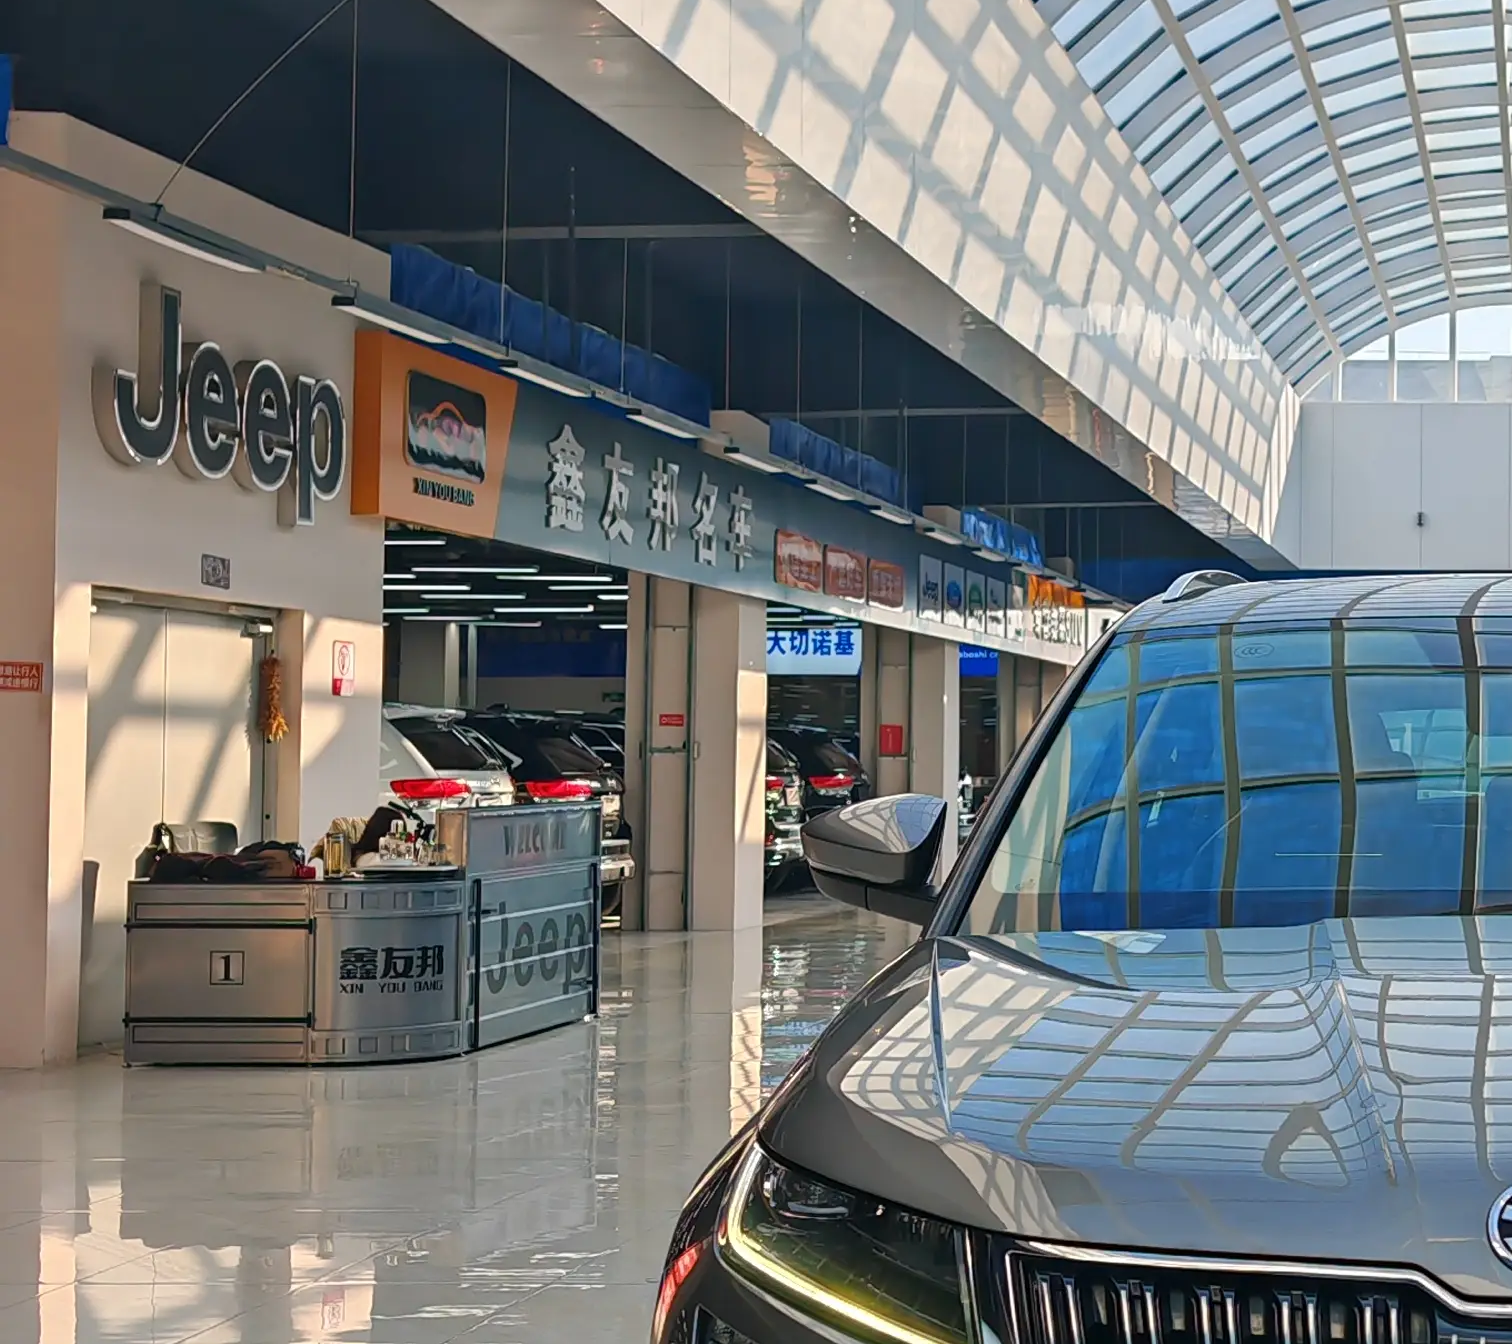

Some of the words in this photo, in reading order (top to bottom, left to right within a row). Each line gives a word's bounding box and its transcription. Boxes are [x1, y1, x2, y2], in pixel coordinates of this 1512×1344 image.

[104, 284, 346, 526] Jeep
[546, 424, 753, 572] 鑫友邦名车
[767, 631, 854, 656] 大切诺基
[339, 944, 445, 981] 鑫友邦
[486, 902, 586, 994] Jeep
[218, 954, 236, 982] 1
[340, 983, 364, 995] XIN
[378, 981, 406, 994] YOU
[414, 979, 444, 993] BANG
